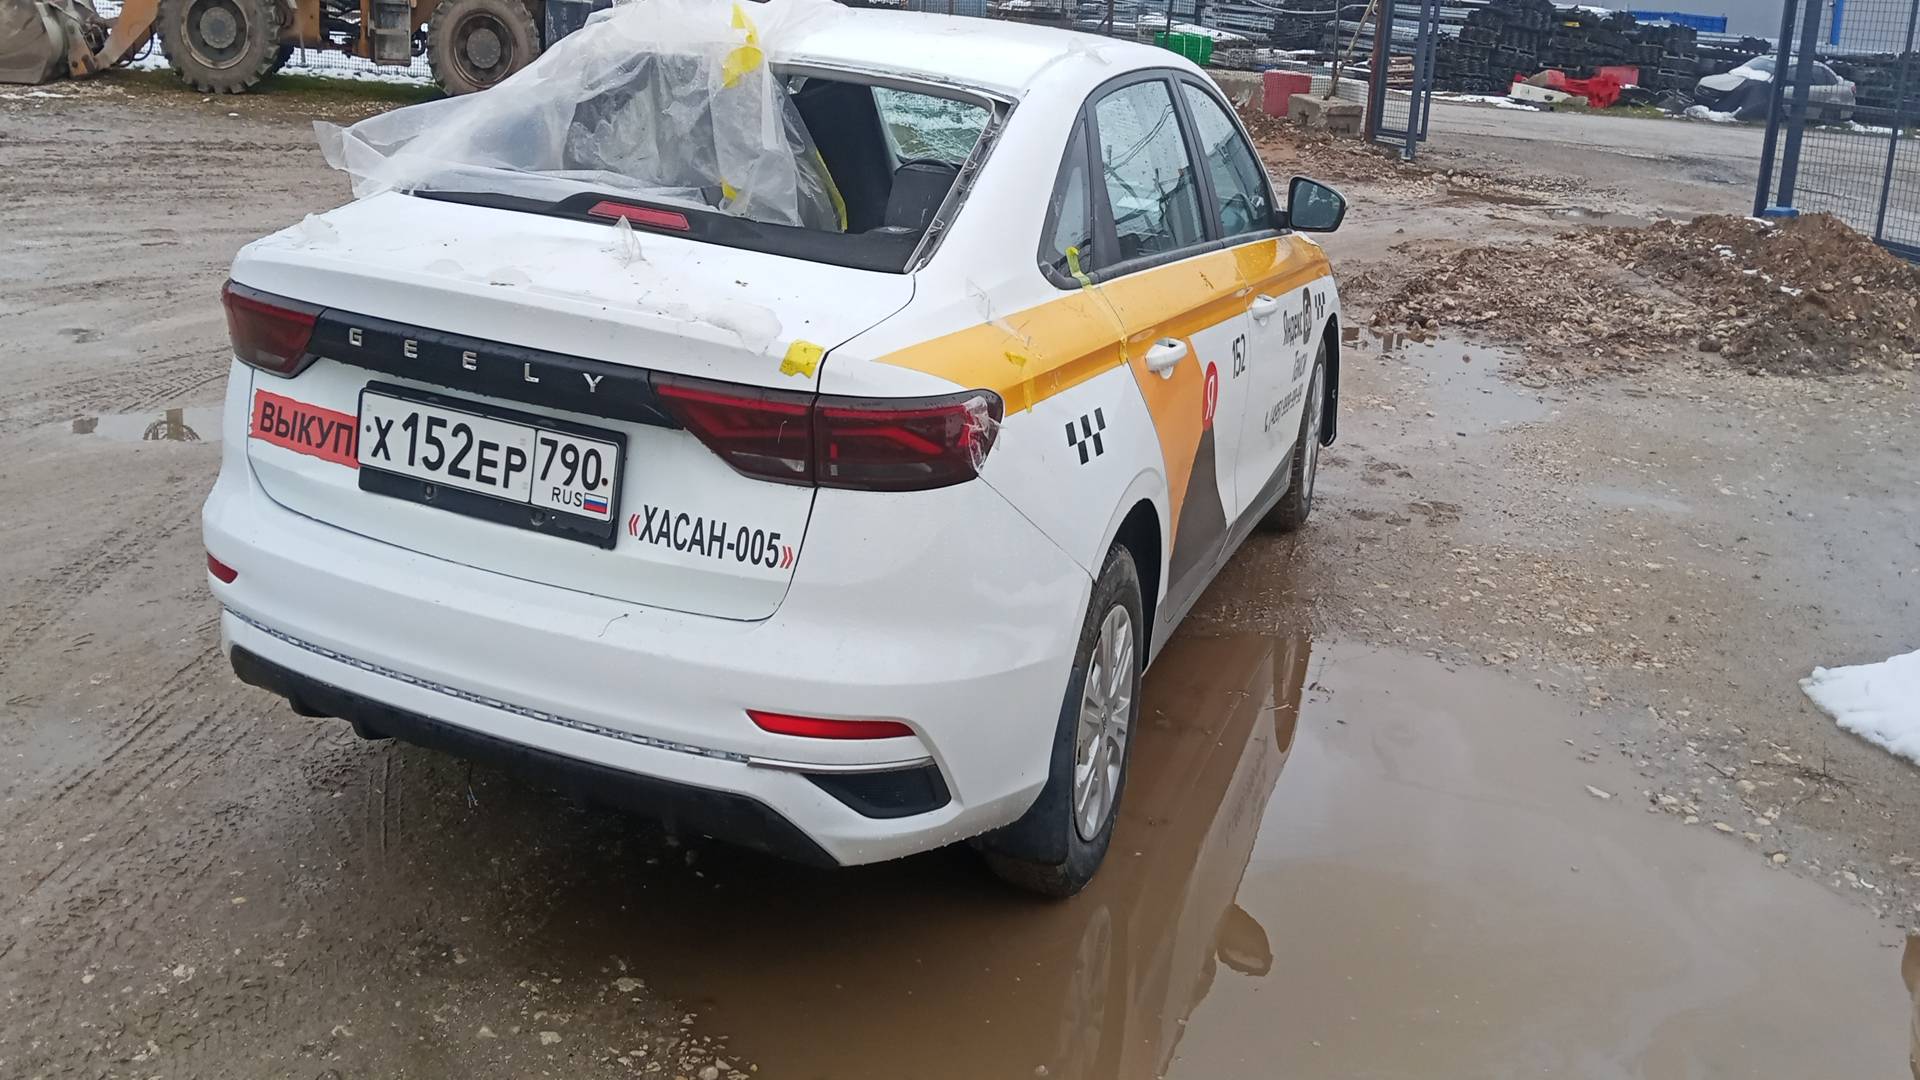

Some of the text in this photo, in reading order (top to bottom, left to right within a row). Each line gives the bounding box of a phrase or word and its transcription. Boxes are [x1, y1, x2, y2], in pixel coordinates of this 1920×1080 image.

[349, 327, 604, 393] GEELY
[1232, 333, 1245, 379] 152
[260, 401, 358, 459] ВЫКУП
[540, 437, 601, 491] 790
[551, 487, 583, 507] RUS
